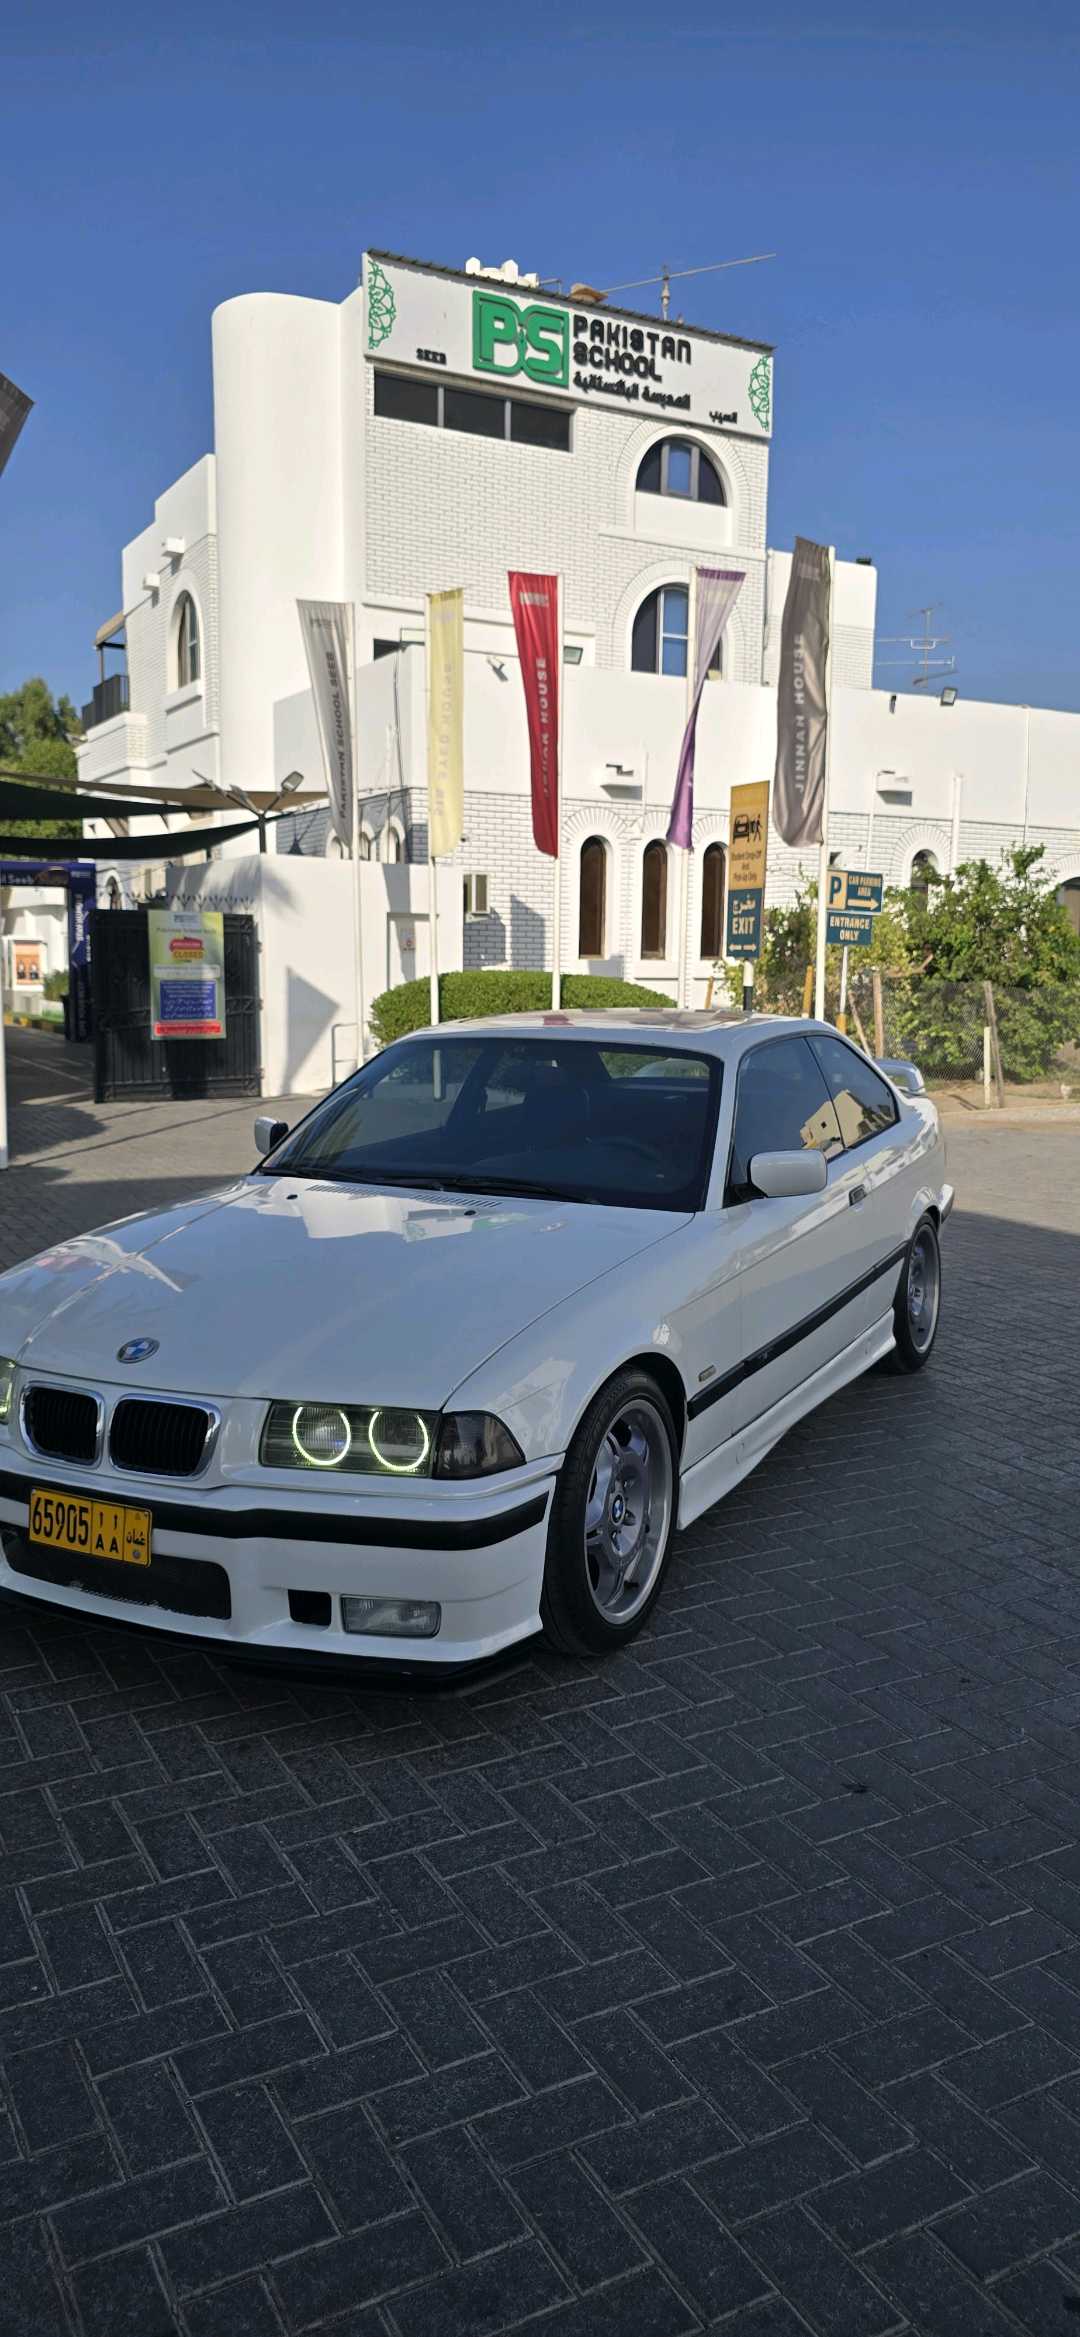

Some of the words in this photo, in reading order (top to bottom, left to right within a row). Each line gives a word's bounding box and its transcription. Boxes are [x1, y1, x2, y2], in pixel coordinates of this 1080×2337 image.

[473, 290, 570, 388] PS
[573, 314, 692, 365] PAKISTAN
[416, 348, 447, 366] SEEB
[573, 341, 662, 383] SCHOOL
[642, 387, 691, 411] المدرسة
[709, 411, 738, 425] السيب
[326, 652, 338, 687] SEEB
[793, 633, 805, 705] HOUSE
[536, 657, 549, 724] HOUSE
[332, 692, 345, 747] SCHOOL
[795, 715, 806, 793] JINNAH
[337, 751, 348, 819] PAKISTAN
[829, 876, 842, 904] P
[848, 874, 859, 886] CAR
[860, 875, 881, 888] PARKING
[857, 886, 871, 896] AREA
[732, 894, 756, 915] مخرج
[732, 917, 755, 935] EXIT
[829, 915, 870, 930] ENTRANCE
[839, 929, 860, 941] ONLY
[32, 1496, 89, 1546] 65905
